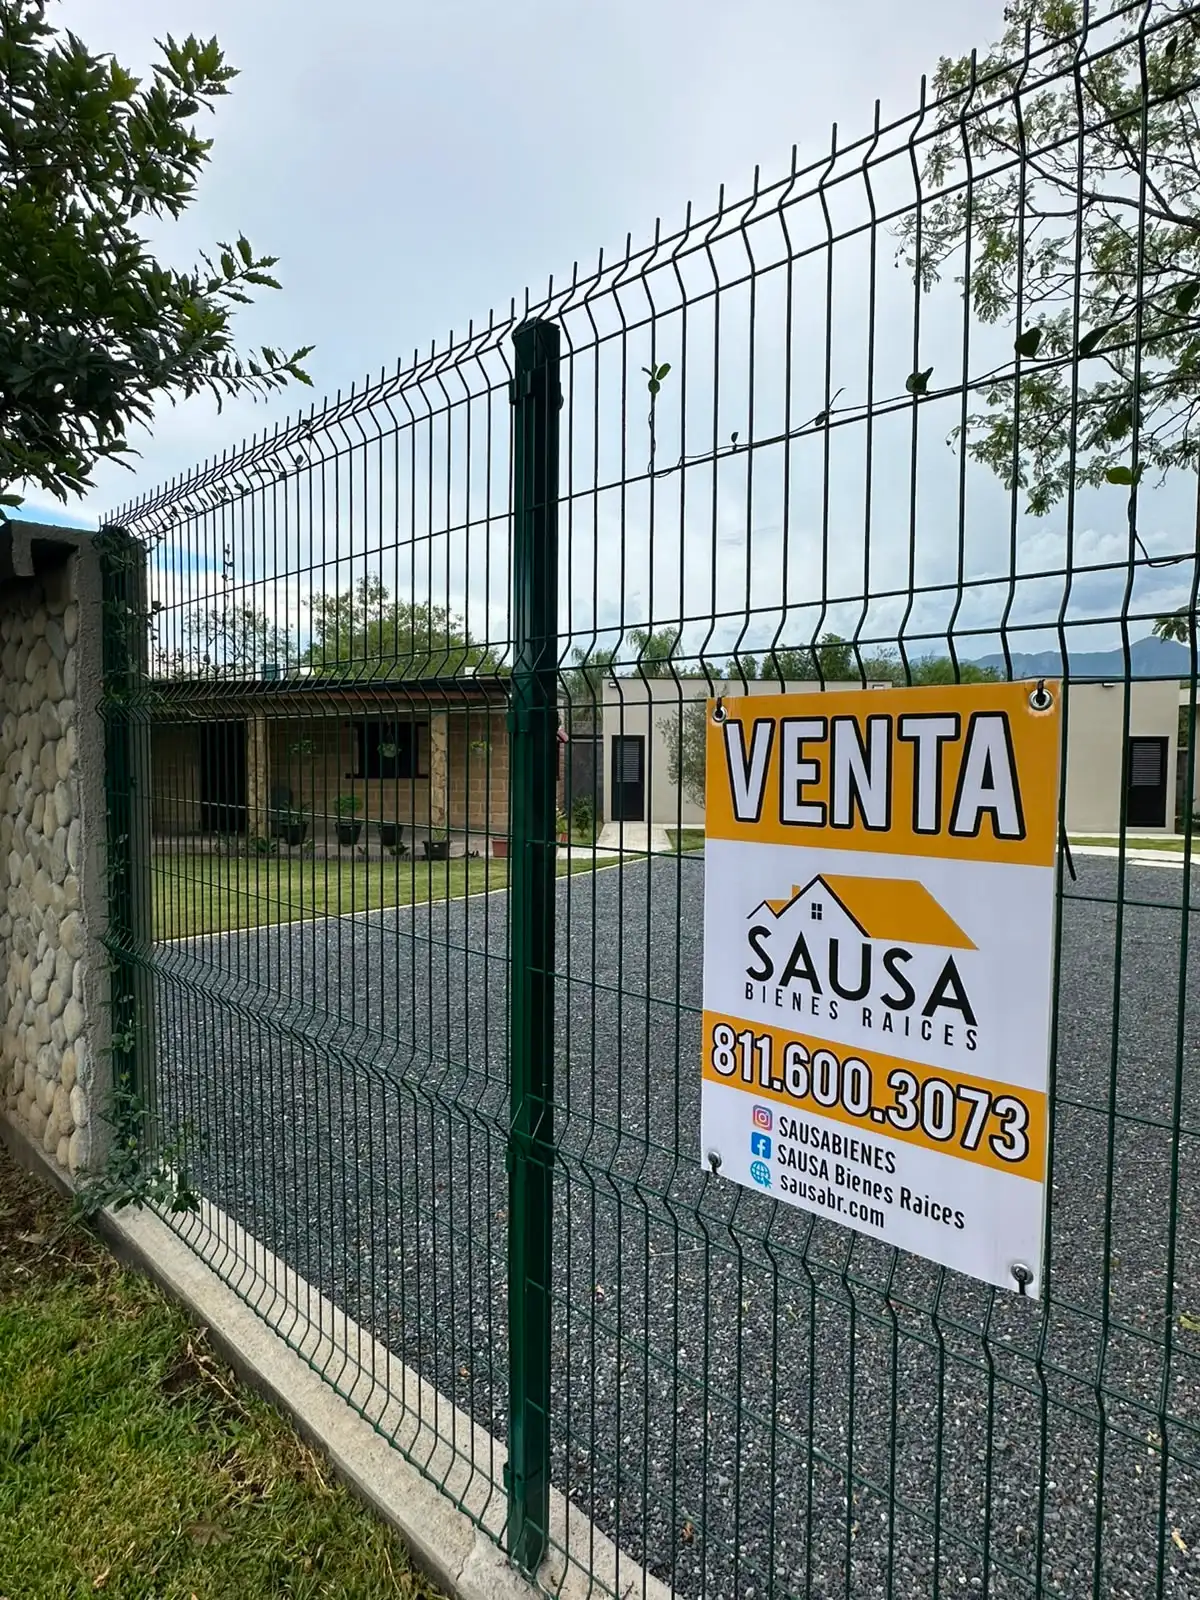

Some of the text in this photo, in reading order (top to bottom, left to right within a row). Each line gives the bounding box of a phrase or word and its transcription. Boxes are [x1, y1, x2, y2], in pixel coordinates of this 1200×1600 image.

[723, 711, 1026, 840] VENTA
[745, 925, 978, 1027] SAUSA
[745, 983, 978, 1051] BIENES RAICES
[711, 1023, 1030, 1163] 811.600.3073
[777, 1144, 965, 1230] SAUSA Bienes Raices
[778, 1116, 896, 1174] SAUSABIENES
[780, 1174, 885, 1228] sausabr.com
